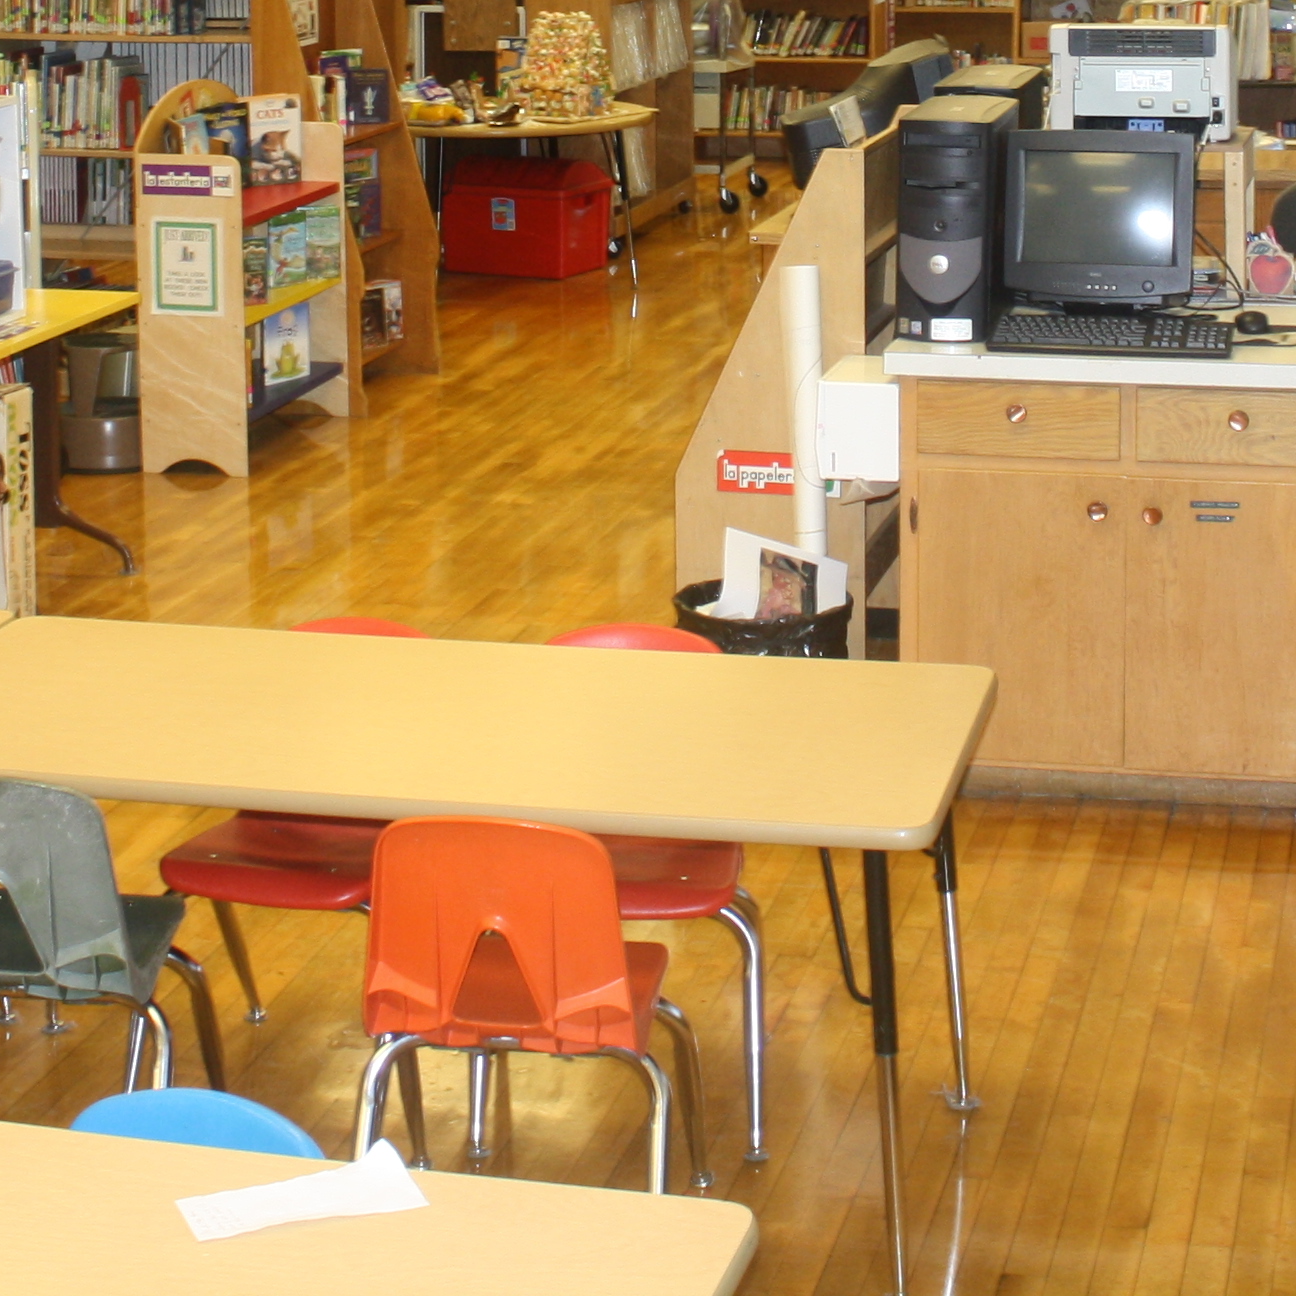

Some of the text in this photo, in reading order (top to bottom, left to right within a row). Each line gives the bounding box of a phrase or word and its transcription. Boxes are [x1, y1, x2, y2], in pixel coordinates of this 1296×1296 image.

[256, 109, 284, 119] CATS
[724, 463, 795, 487] la papeler
